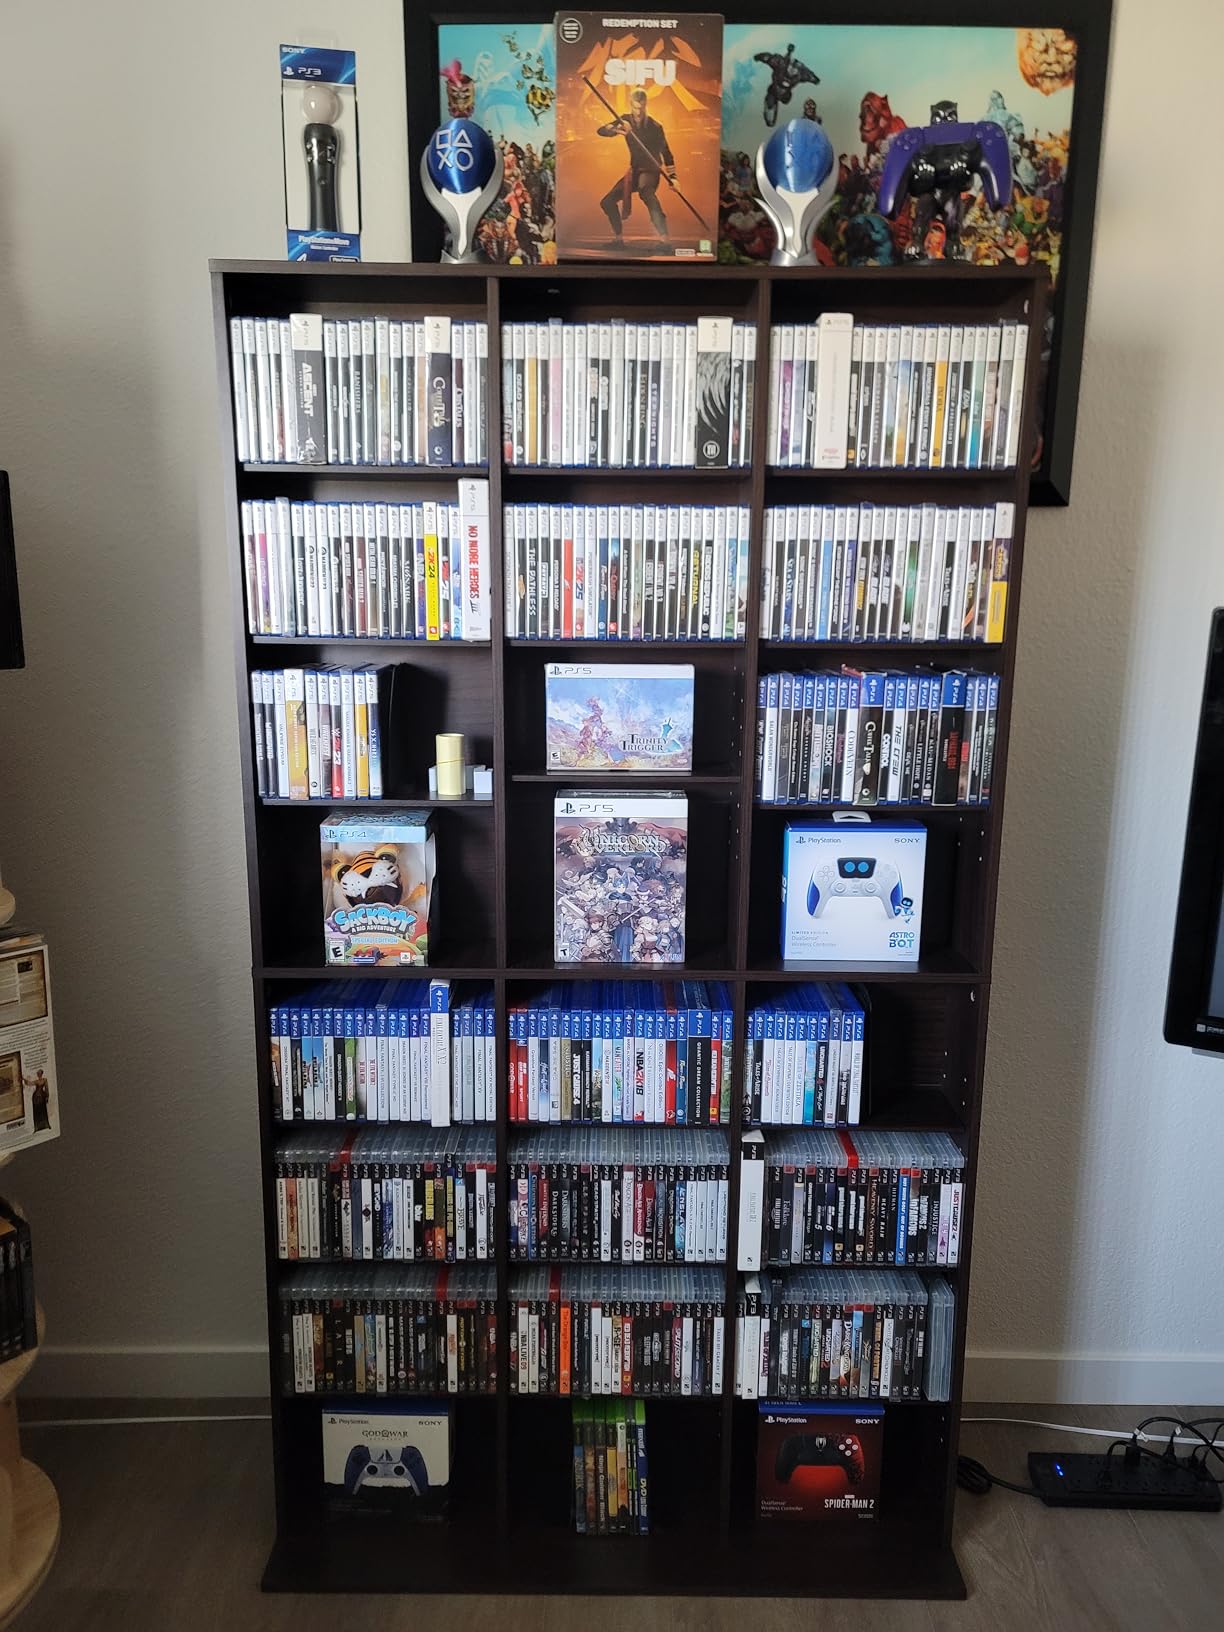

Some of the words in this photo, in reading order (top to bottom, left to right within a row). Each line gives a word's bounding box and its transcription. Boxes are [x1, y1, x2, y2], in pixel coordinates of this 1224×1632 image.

[602, 18, 659, 28] REDEMPTION
[661, 19, 678, 28] SET
[298, 67, 321, 75] PS3
[604, 58, 676, 86] SIFU
[468, 525, 478, 537] NO
[469, 540, 478, 565] MORE
[704, 555, 712, 580] RIDERS
[469, 568, 479, 599] HEROES
[564, 667, 592, 675] PS5
[621, 740, 663, 751] TRIGGER
[629, 733, 668, 745] TRINITY
[824, 725, 834, 766] BIOSHOCK
[333, 736, 341, 766] 2K23
[881, 733, 890, 769] CONTROL
[892, 748, 901, 776] CREW
[579, 804, 613, 812] PS5
[335, 905, 416, 932] SACKBOY
[332, 947, 343, 957] E
[889, 939, 915, 948] BOT
[415, 1205, 423, 1222] blur
[782, 1200, 790, 1226] Folklore
[908, 1199, 919, 1236] inFAMOUS
[919, 1195, 929, 1224] inFAMOUS
[931, 1200, 939, 1235] INJUSTICE
[749, 1294, 757, 1314] PS3
[521, 1362, 527, 1370] 09
[824, 1499, 867, 1509] SPIDER-MAN
[869, 1499, 875, 1508] 2
